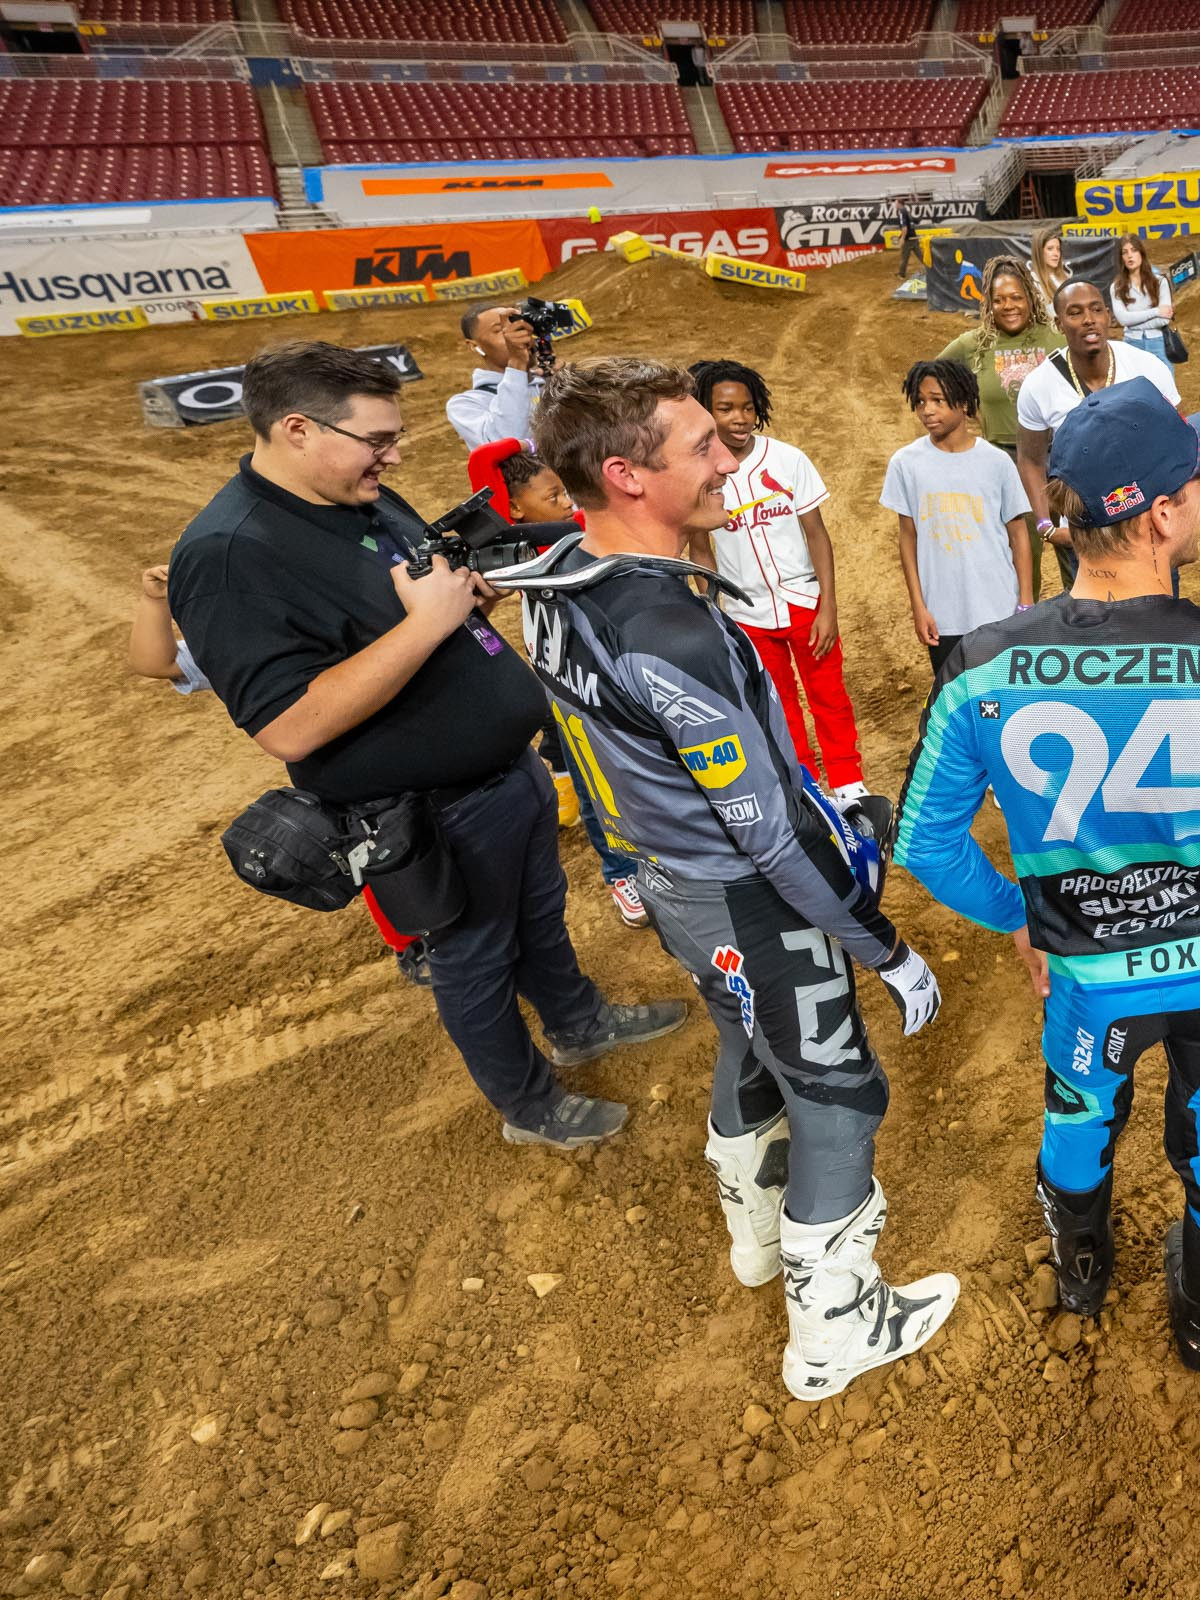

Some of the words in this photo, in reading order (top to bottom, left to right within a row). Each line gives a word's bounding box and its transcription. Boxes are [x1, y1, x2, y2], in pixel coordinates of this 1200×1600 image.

[811, 206, 873, 222] ROCKY
[354, 244, 472, 286] KTM
[720, 263, 800, 289] SUZUKI
[1172, 260, 1193, 276] GoPro
[28, 310, 135, 334] SUZUKI
[213, 298, 310, 320] SUZUKI
[750, 502, 793, 530] Louis
[1105, 502, 1127, 517] Red
[1126, 491, 1144, 509] Bull
[681, 741, 739, 771] WD-40
[1060, 866, 1200, 895] PROGRESSIVE
[1079, 882, 1199, 917] SUZUKI
[1093, 904, 1200, 939] ECSTAR
[1125, 942, 1198, 977] FOX
